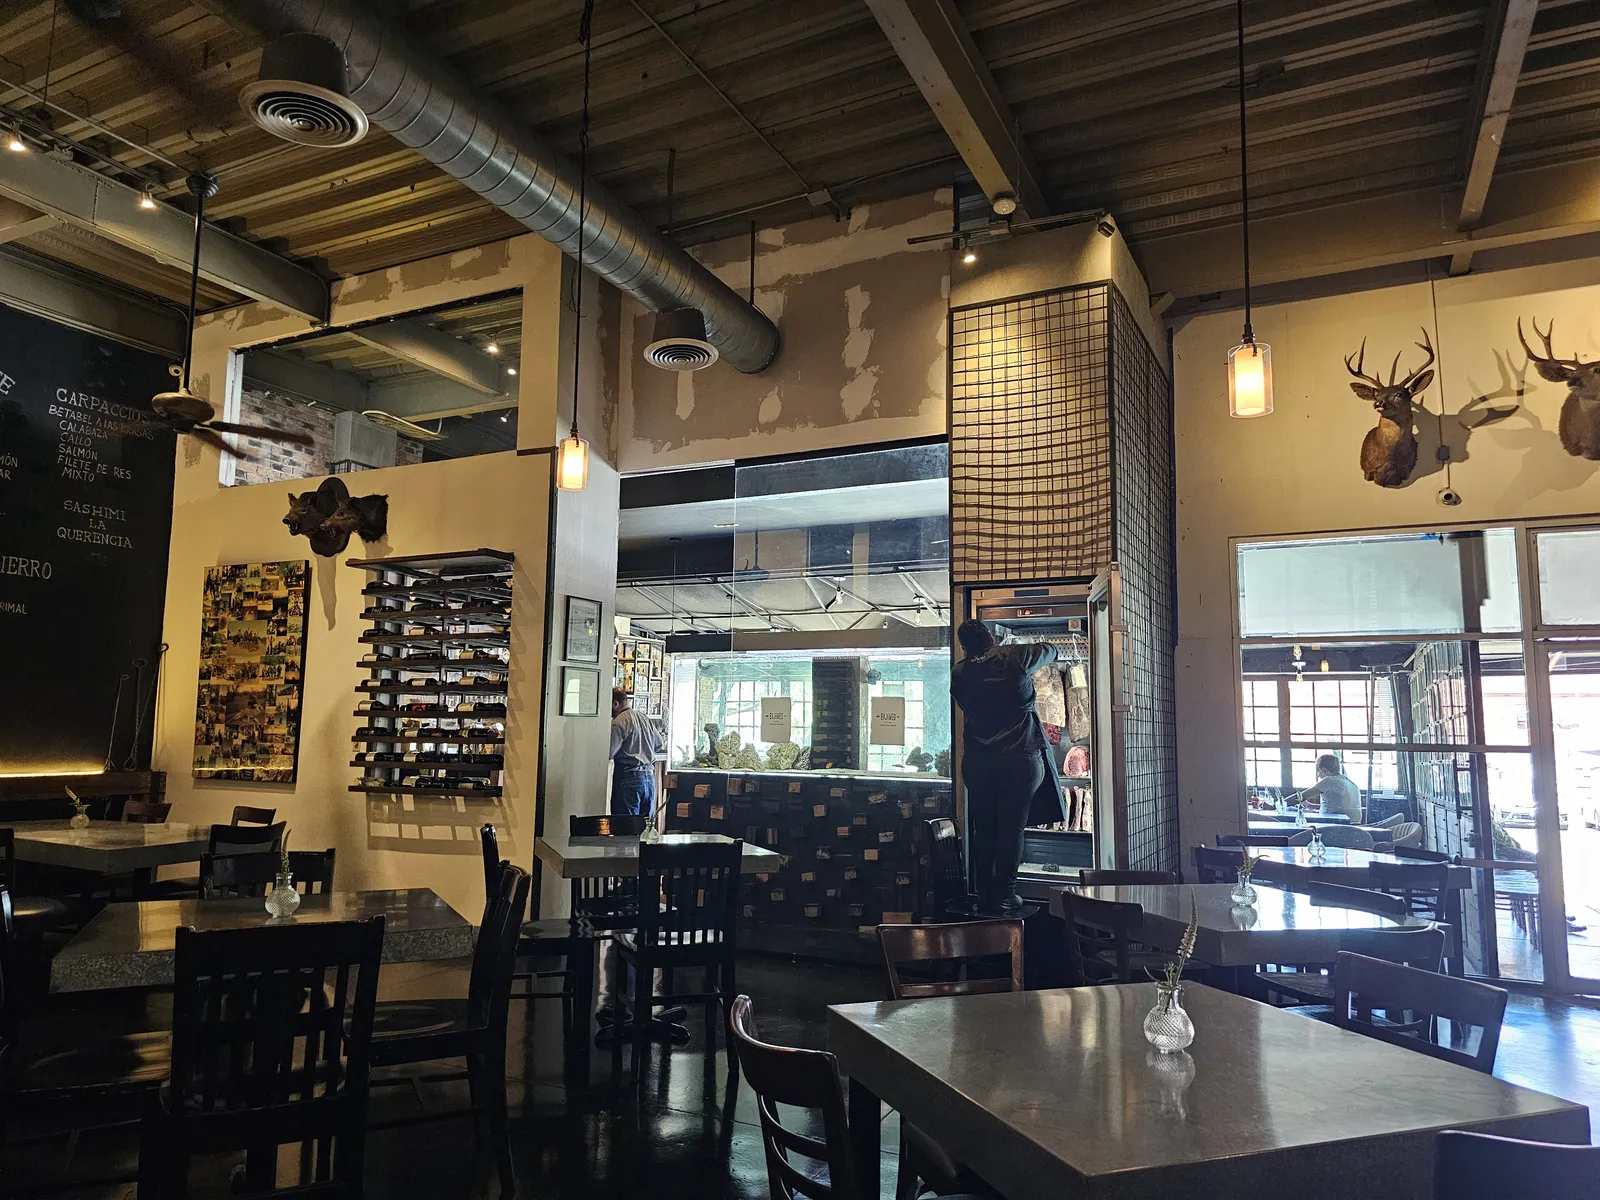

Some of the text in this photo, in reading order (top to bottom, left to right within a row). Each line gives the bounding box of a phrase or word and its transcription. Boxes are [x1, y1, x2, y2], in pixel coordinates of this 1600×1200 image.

[56, 388, 150, 425] CARPACCIOS
[48, 404, 93, 425] BETABEL
[95, 417, 103, 428] A
[103, 420, 118, 432] LAS
[59, 420, 109, 441] CALABAZA
[60, 432, 92, 448] CALLO
[58, 443, 98, 462] SALMÓN
[57, 454, 132, 480] FILETE DE RES
[61, 466, 96, 483] MIXTO
[63, 500, 127, 522] SASHIMI
[89, 518, 107, 531] LA
[57, 526, 134, 549] QUERENCIA
